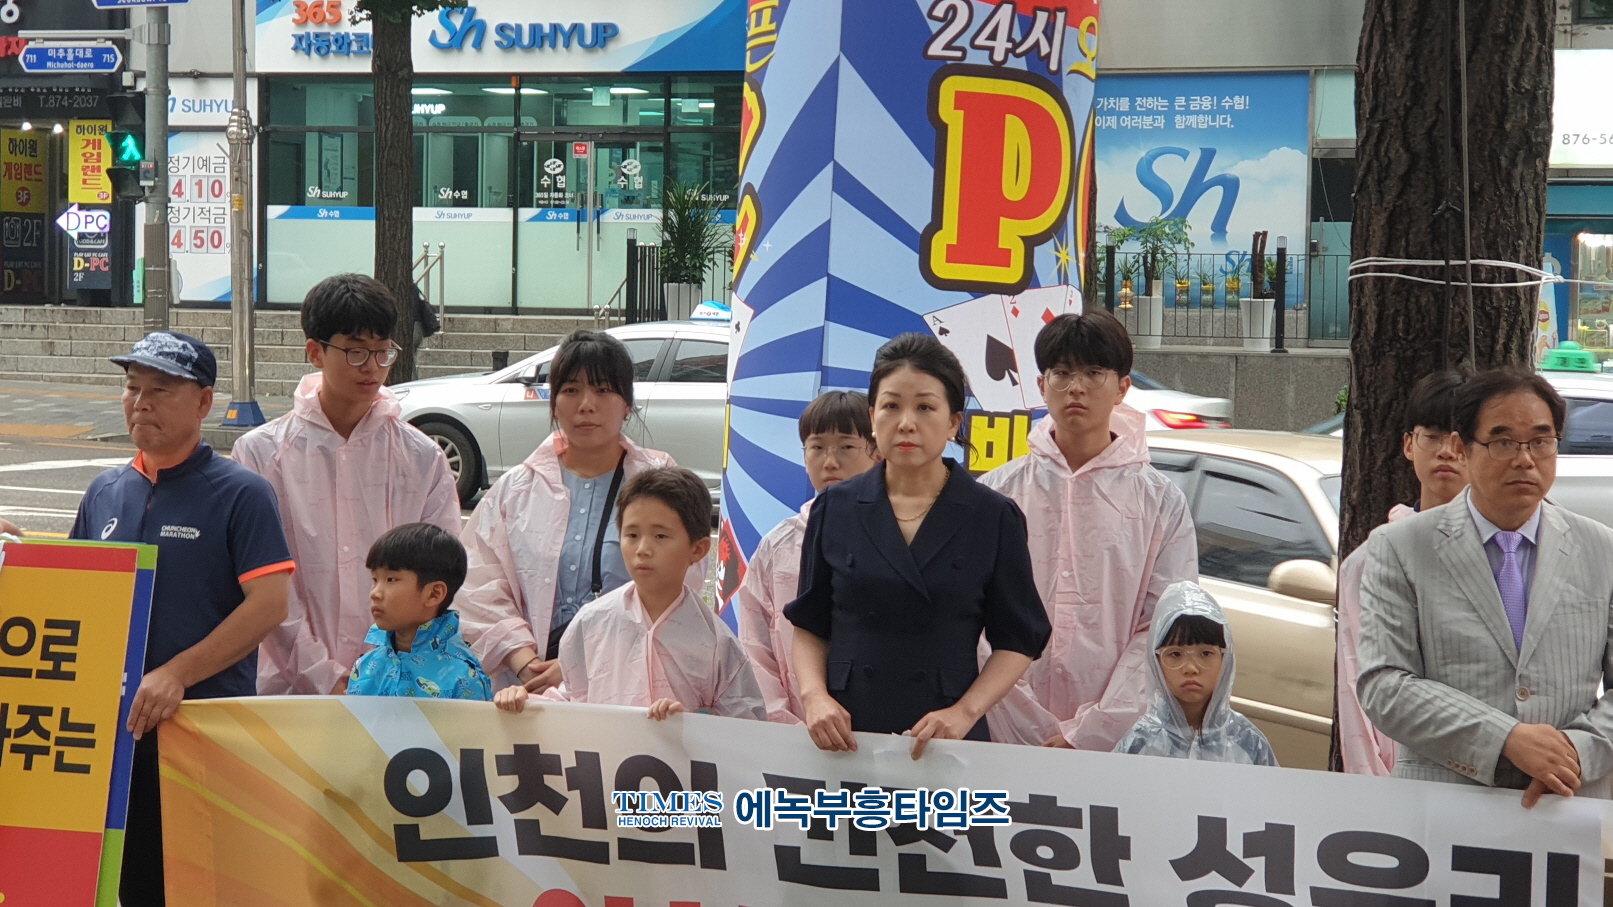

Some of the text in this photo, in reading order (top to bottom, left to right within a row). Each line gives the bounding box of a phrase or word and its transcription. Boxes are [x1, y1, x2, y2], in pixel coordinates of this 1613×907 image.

[292, 0, 342, 25] 365
[428, 7, 619, 51] Sh SUHYUP
[925, 0, 1067, 71] 24시
[291, 31, 374, 56] 자동화코
[25, 54, 37, 63] 711
[48, 48, 93, 60] 미추홀대로
[102, 54, 115, 63] 715
[47, 61, 94, 69] Michuhol-daero
[39, 95, 99, 108] T.874-2037
[182, 98, 236, 113] SUHYU
[1096, 95, 1250, 111] 가치를 전하는 큰 금융! 수협!
[1095, 114, 1234, 129] 이제 여러분과 함께합니다.
[8, 137, 38, 157] 하이원
[3, 161, 43, 182] 게임랜드
[80, 138, 103, 190] 게임랜드
[168, 155, 227, 174] 정기예금
[540, 175, 566, 189] 수협
[936, 80, 1071, 278] P
[17, 190, 30, 202] 3F
[307, 186, 320, 198] Sh
[438, 187, 468, 199] Sh 수협
[1114, 146, 1241, 236] Sh
[168, 206, 227, 224] 정기적금
[73, 257, 109, 271] D-PC
[73, 272, 84, 281] 2F
[160, 531, 195, 540] MARATHON
[384, 744, 727, 871] 인천의
